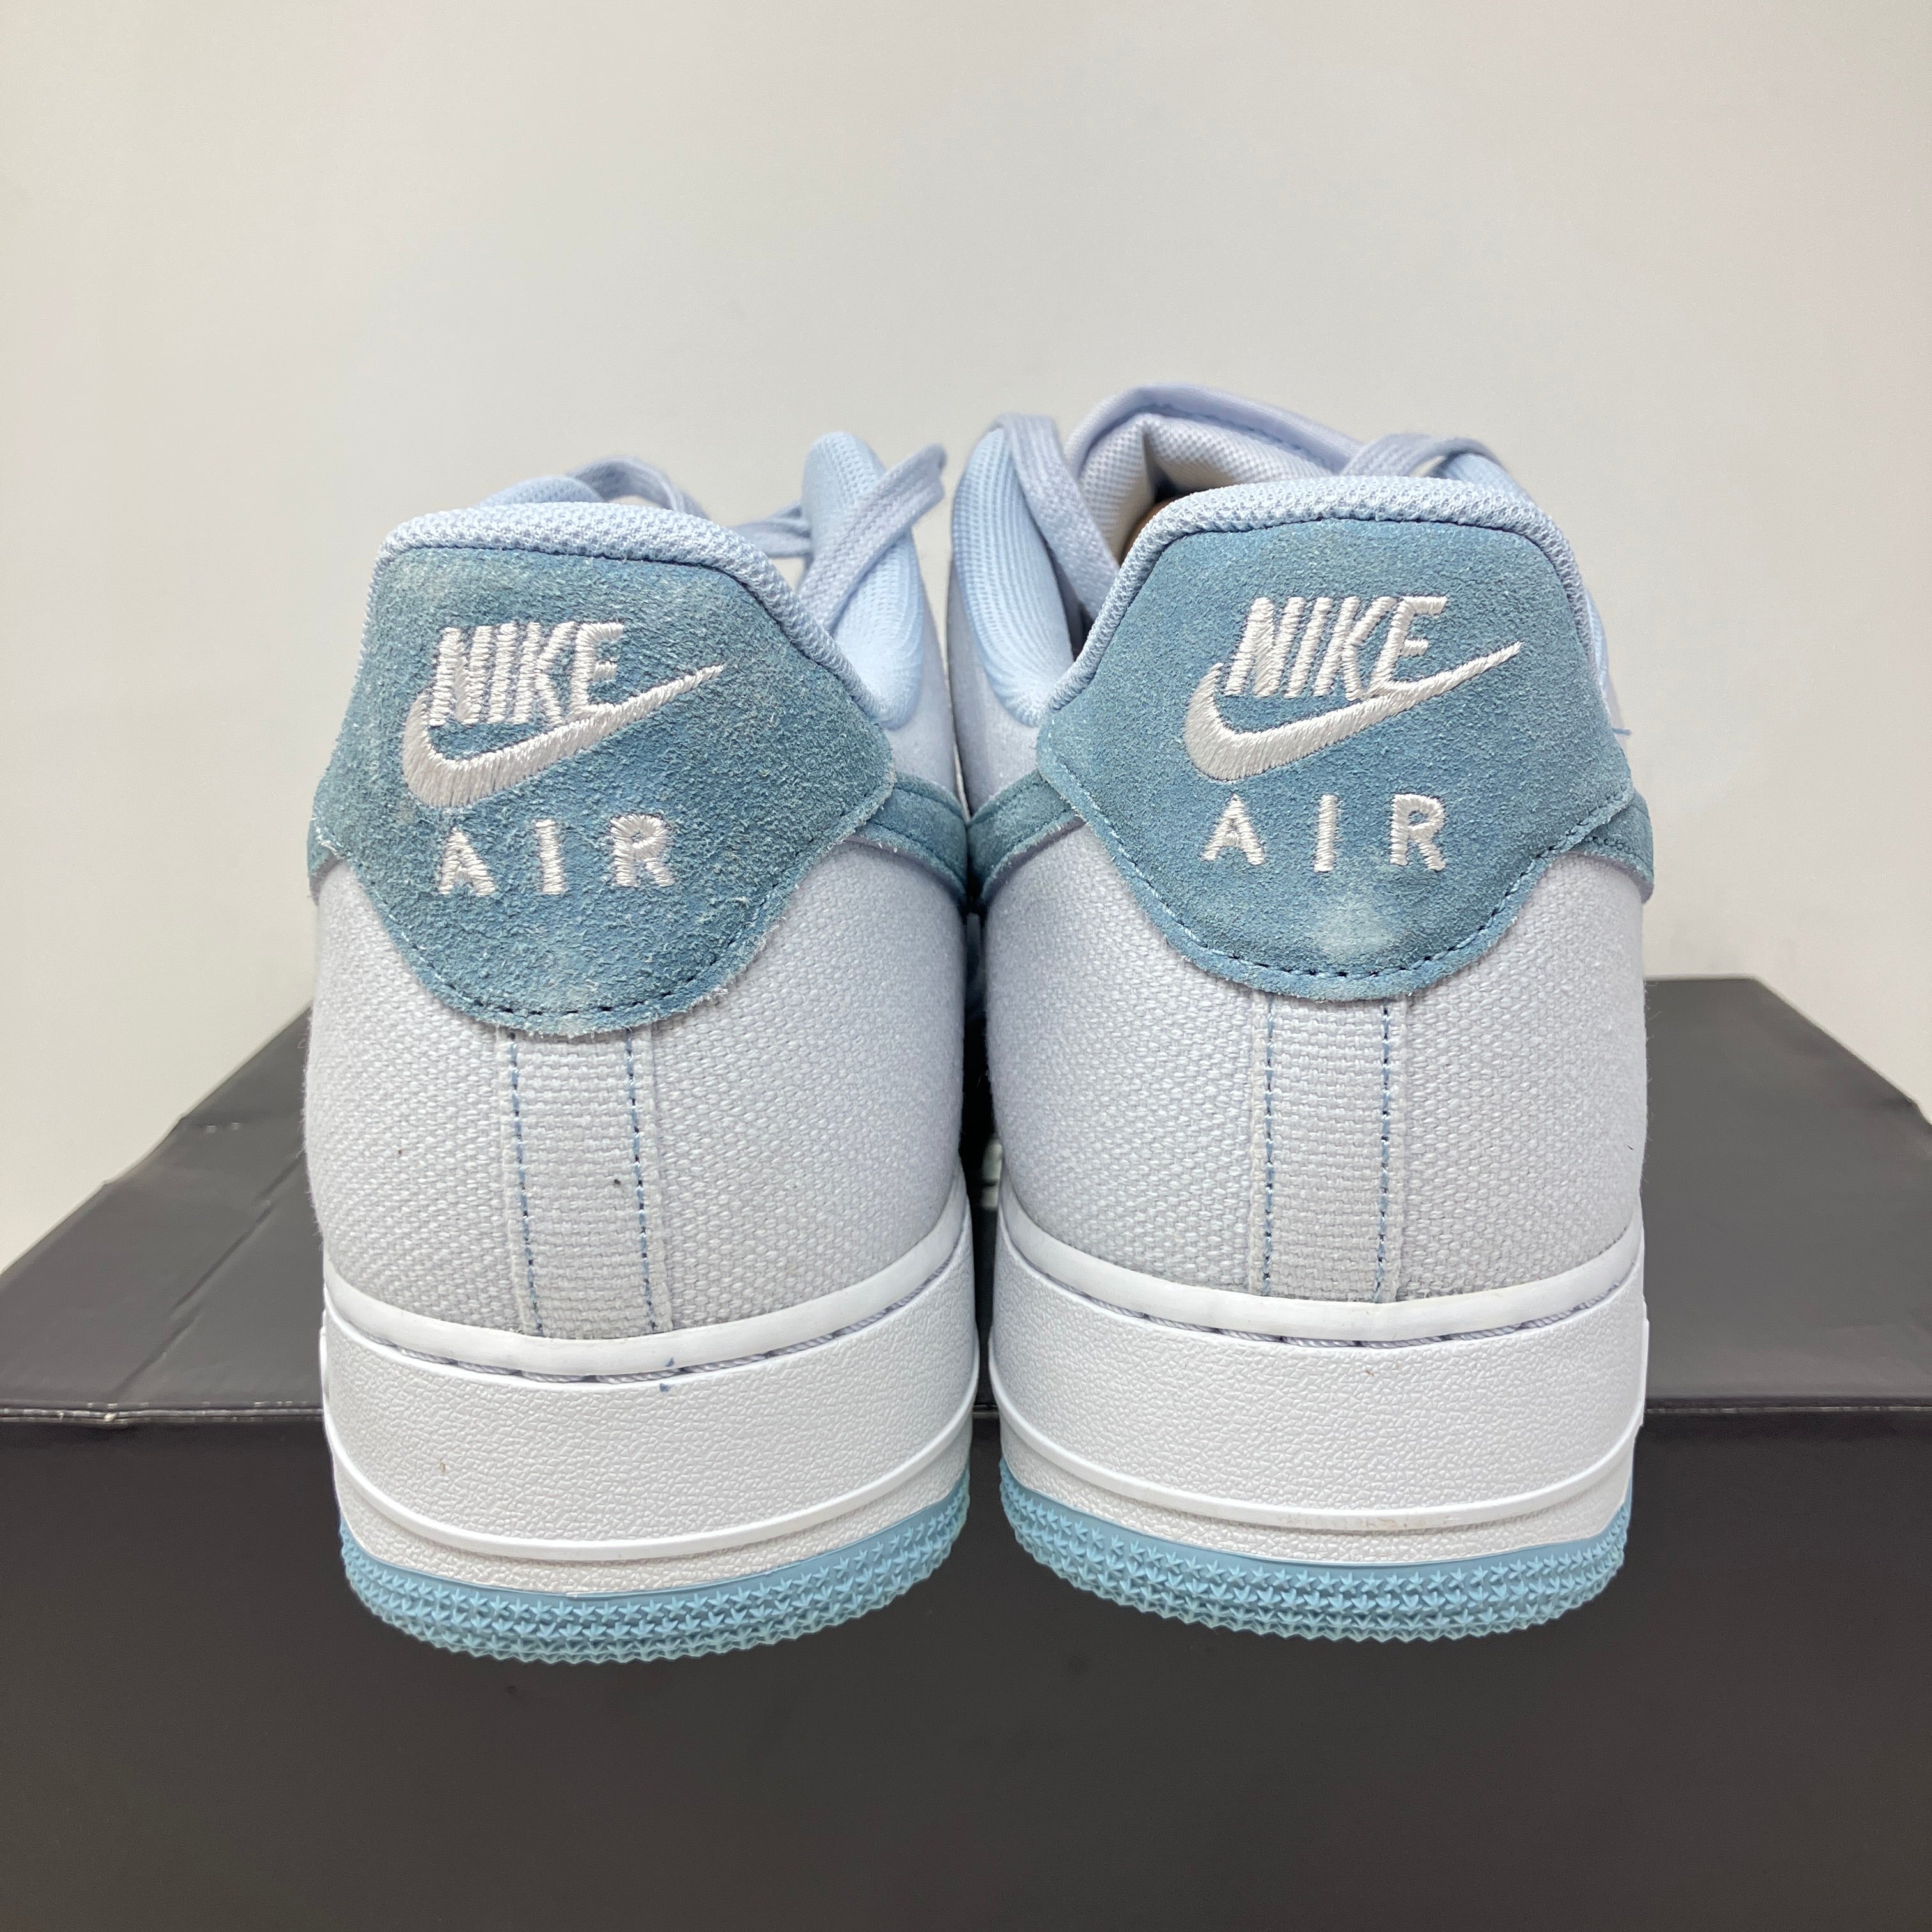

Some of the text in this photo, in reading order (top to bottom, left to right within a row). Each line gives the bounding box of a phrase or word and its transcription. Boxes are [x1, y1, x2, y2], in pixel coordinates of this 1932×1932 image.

[427, 619, 625, 726] NIKE
[1224, 595, 1448, 700] NIKE
[438, 813, 675, 894] AIR
[1200, 792, 1446, 872] AIR
